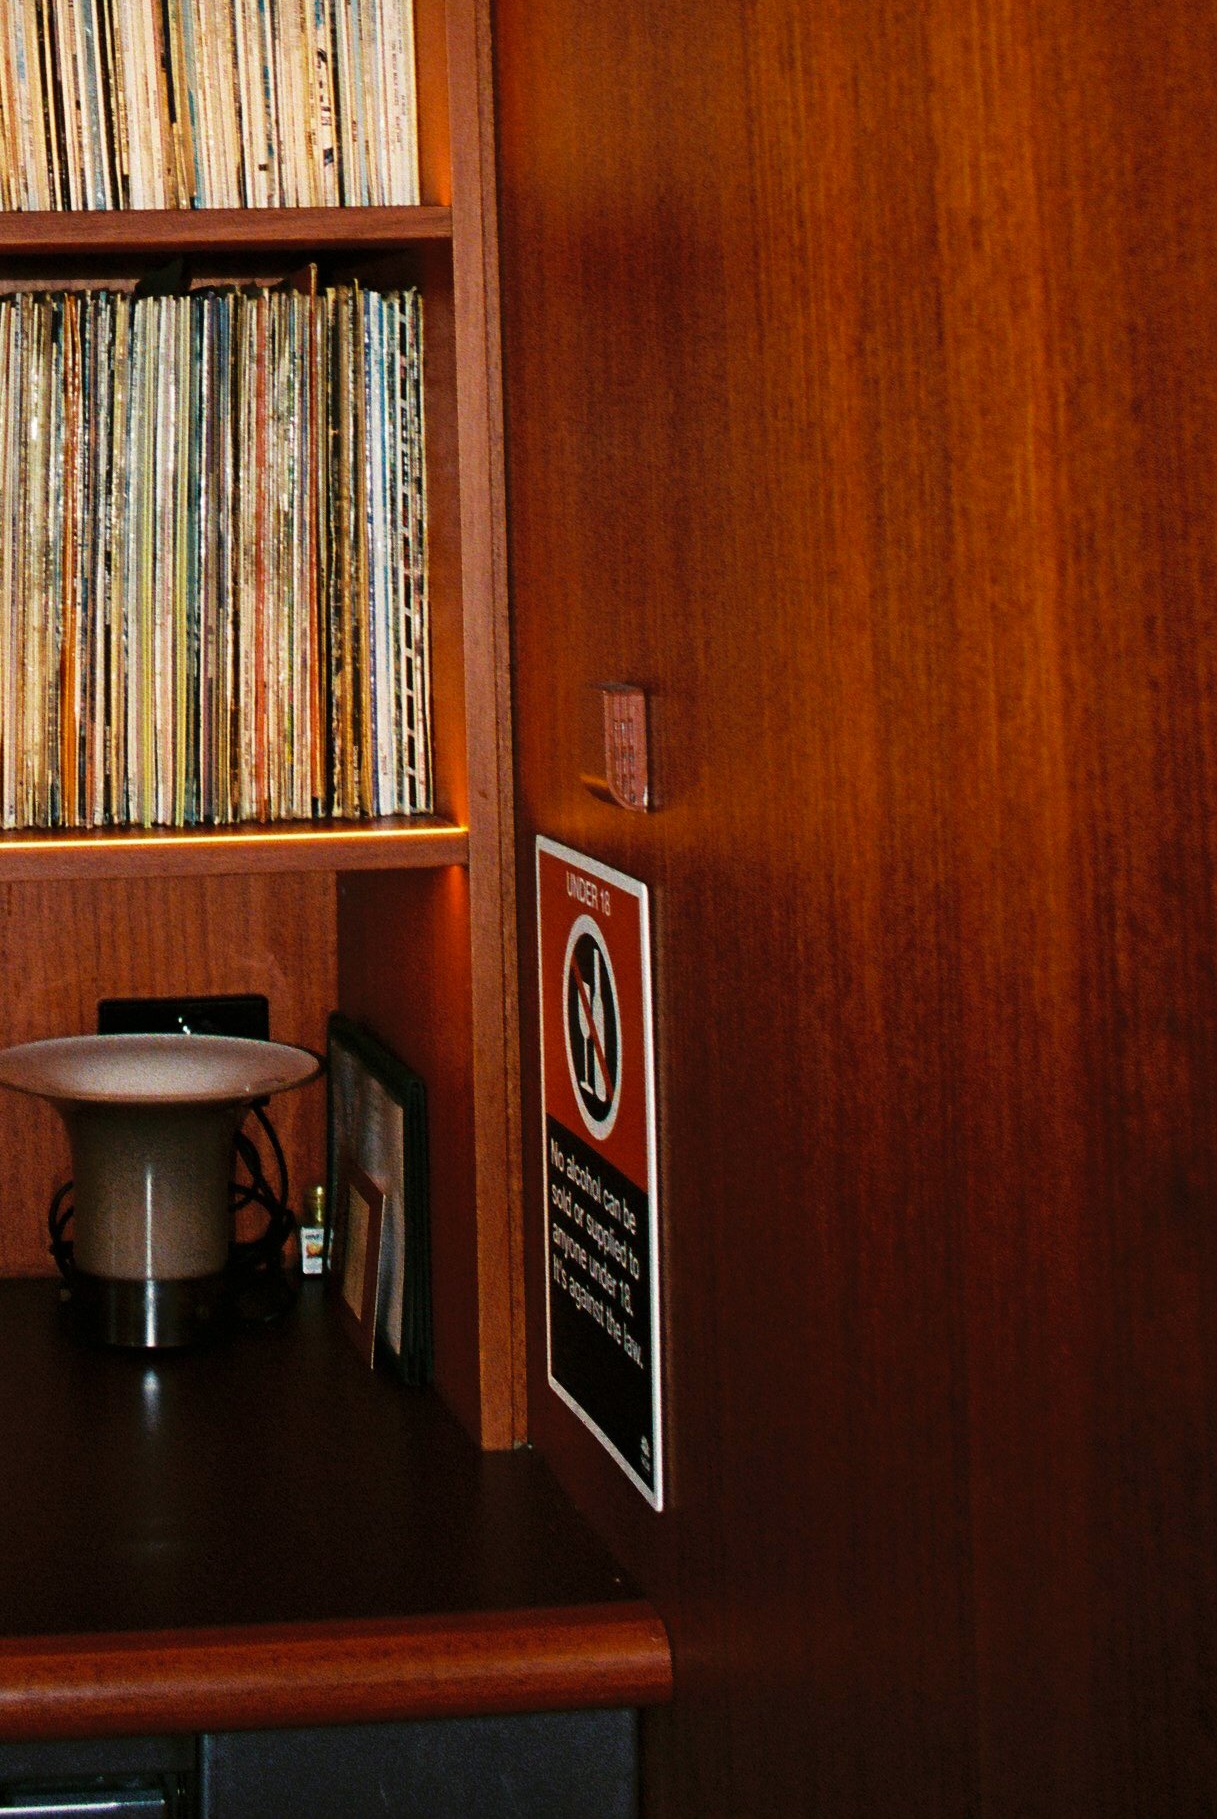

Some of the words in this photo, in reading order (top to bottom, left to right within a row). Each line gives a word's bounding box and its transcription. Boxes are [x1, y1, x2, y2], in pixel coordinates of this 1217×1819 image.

[566, 871, 599, 911] UNDER
[600, 889, 611, 916] 18
[550, 1137, 565, 1172] No
[567, 1154, 602, 1204] alcohol
[604, 1188, 622, 1222] can
[623, 1197, 636, 1235] be
[551, 1183, 572, 1218] sold
[574, 1203, 585, 1228] or
[586, 1213, 627, 1269] supplied
[629, 1247, 640, 1280] to
[552, 1222, 587, 1270] anyone
[589, 1254, 617, 1299] under
[619, 1279, 634, 1318] 18.
[553, 1253, 568, 1290] It's
[569, 1275, 604, 1327] against
[606, 1305, 622, 1345] the
[623, 1321, 644, 1369] law.
